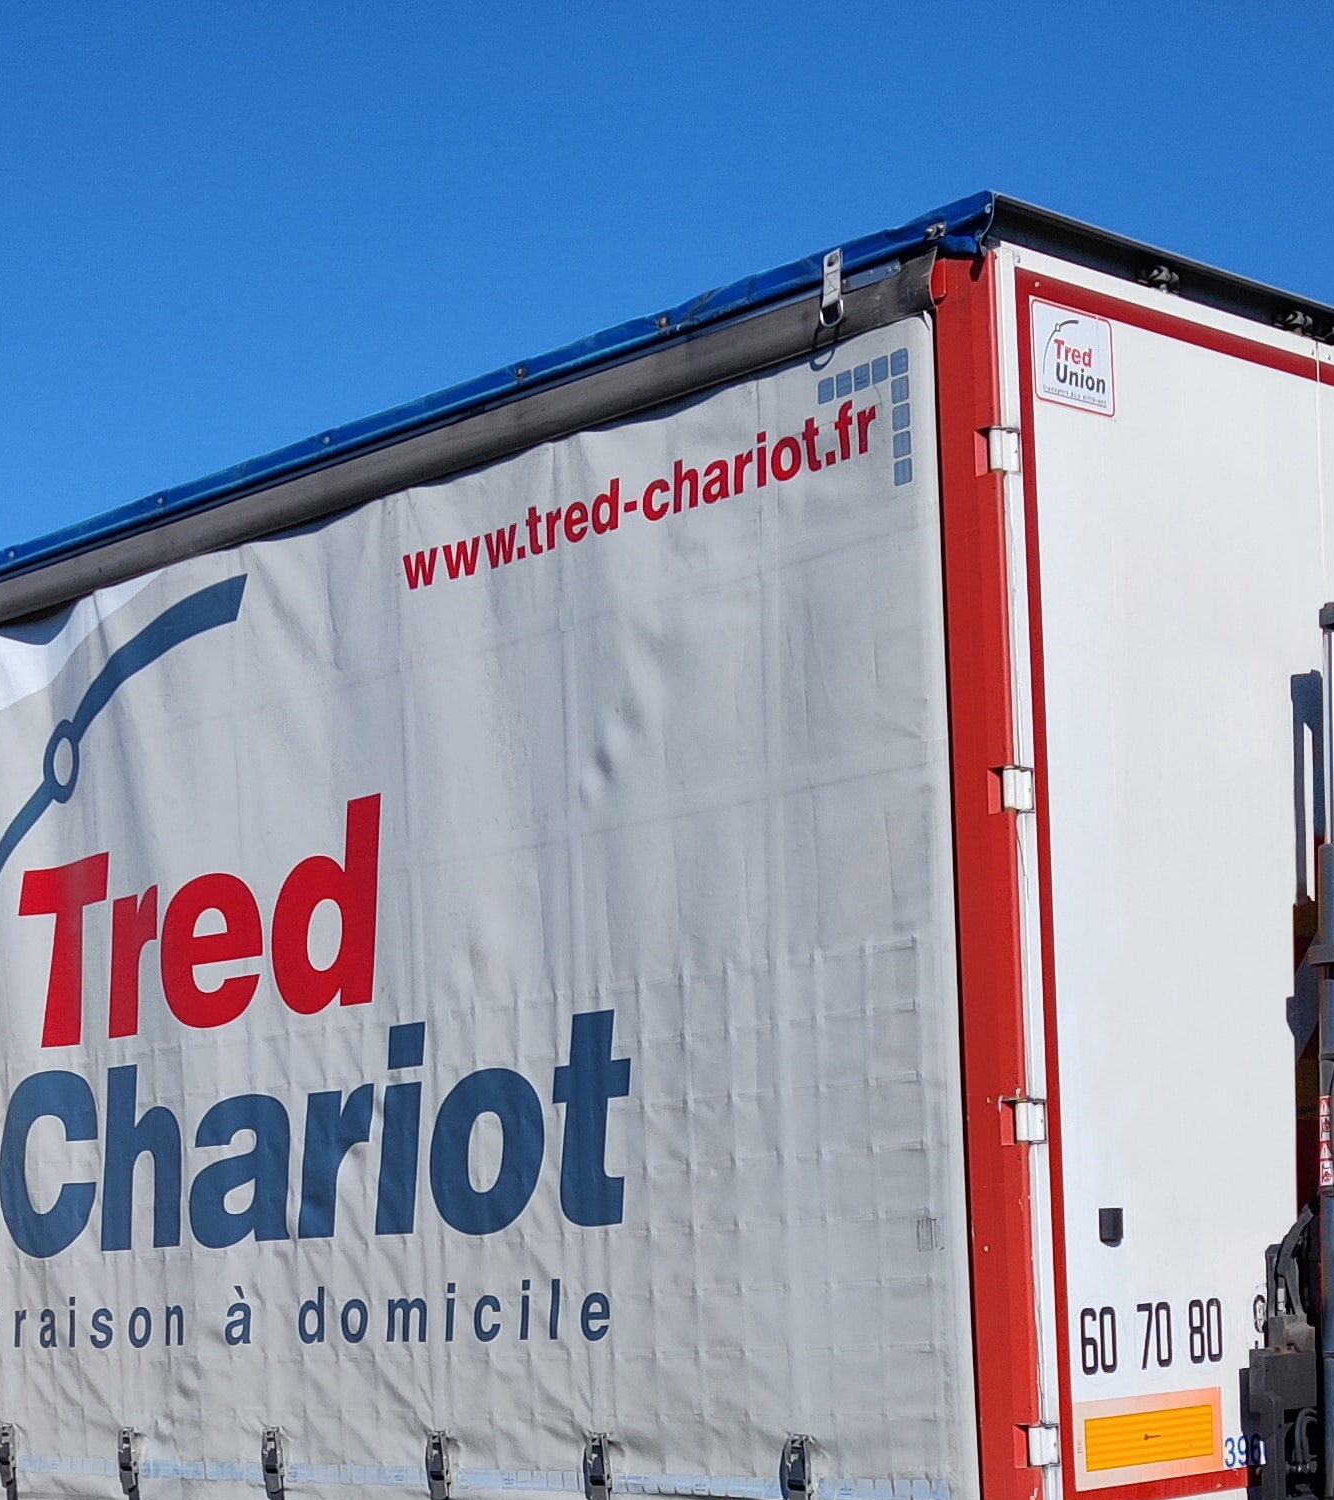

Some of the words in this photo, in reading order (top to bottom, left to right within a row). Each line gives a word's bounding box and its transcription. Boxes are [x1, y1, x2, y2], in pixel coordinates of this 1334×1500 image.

[1054, 339, 1092, 368] Tred
[1056, 362, 1106, 394] Union
[402, 401, 876, 590] www.tred-chariot.fr
[18, 794, 381, 1048] Tred
[224, 1285, 252, 1346] à
[298, 1278, 611, 1344] domicile
[1080, 1306, 1118, 1375] 60
[1137, 1301, 1173, 1370] 70
[1188, 1297, 1223, 1364] 80
[1253, 1294, 1267, 1350] 9
[1224, 1433, 1267, 1469] 396
